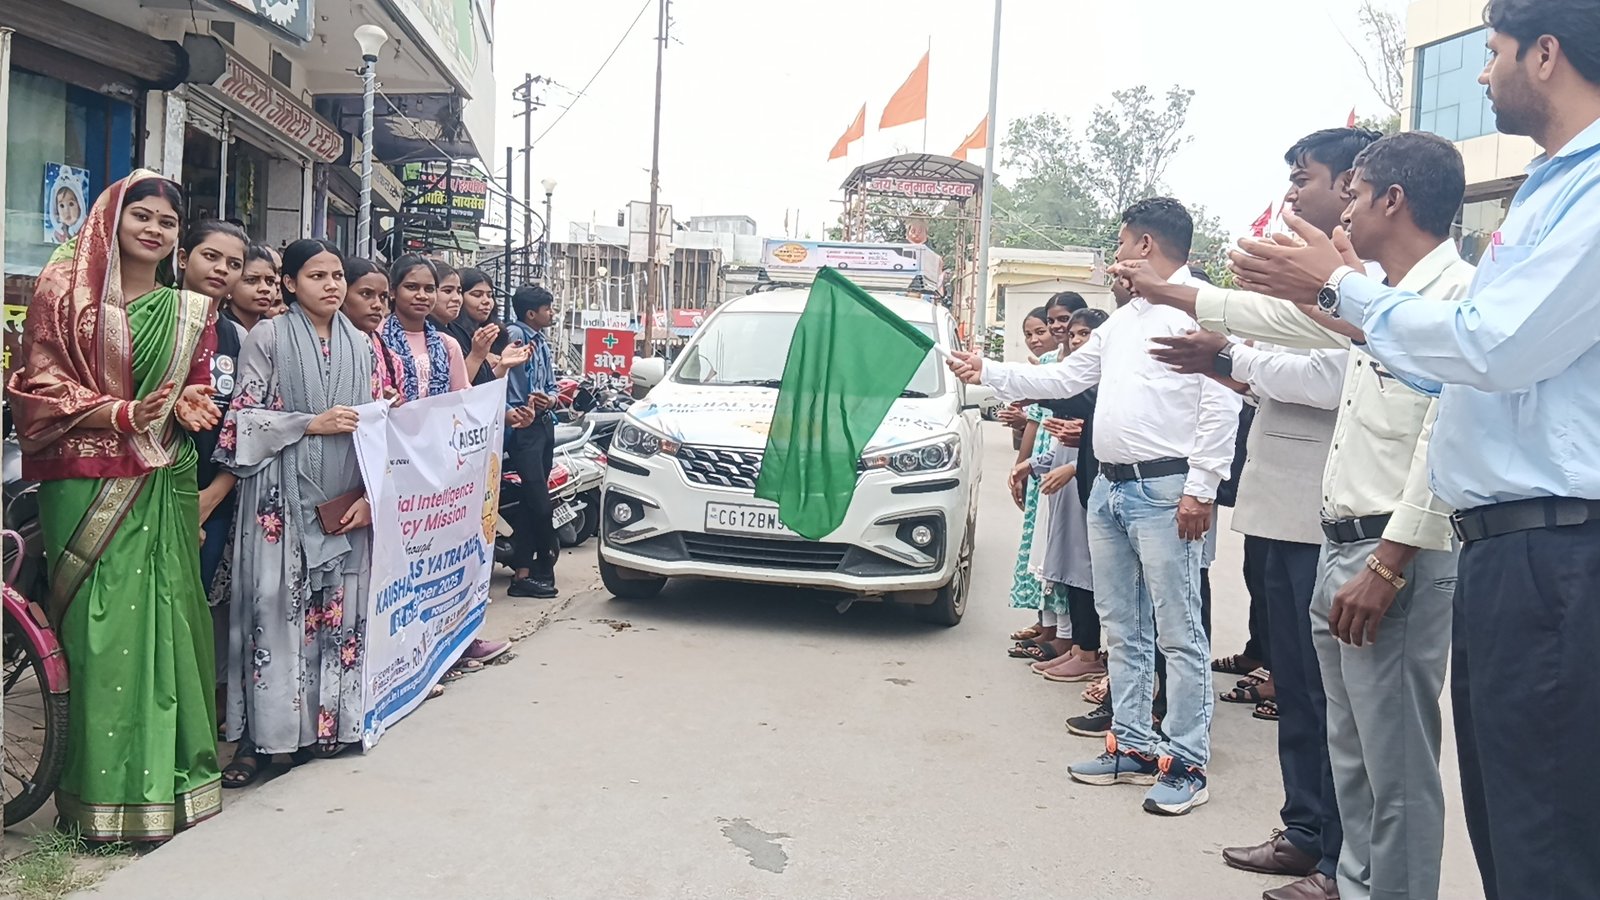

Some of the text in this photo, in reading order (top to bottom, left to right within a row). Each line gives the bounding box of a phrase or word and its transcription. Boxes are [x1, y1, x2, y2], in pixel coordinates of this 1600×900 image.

[872, 180, 974, 197] जय हनुमान दरबार
[593, 350, 626, 369] ओम
[459, 425, 488, 450] AISECT
[416, 482, 474, 511] Intelligence
[424, 505, 467, 532] Mission
[427, 544, 462, 576] YATRA
